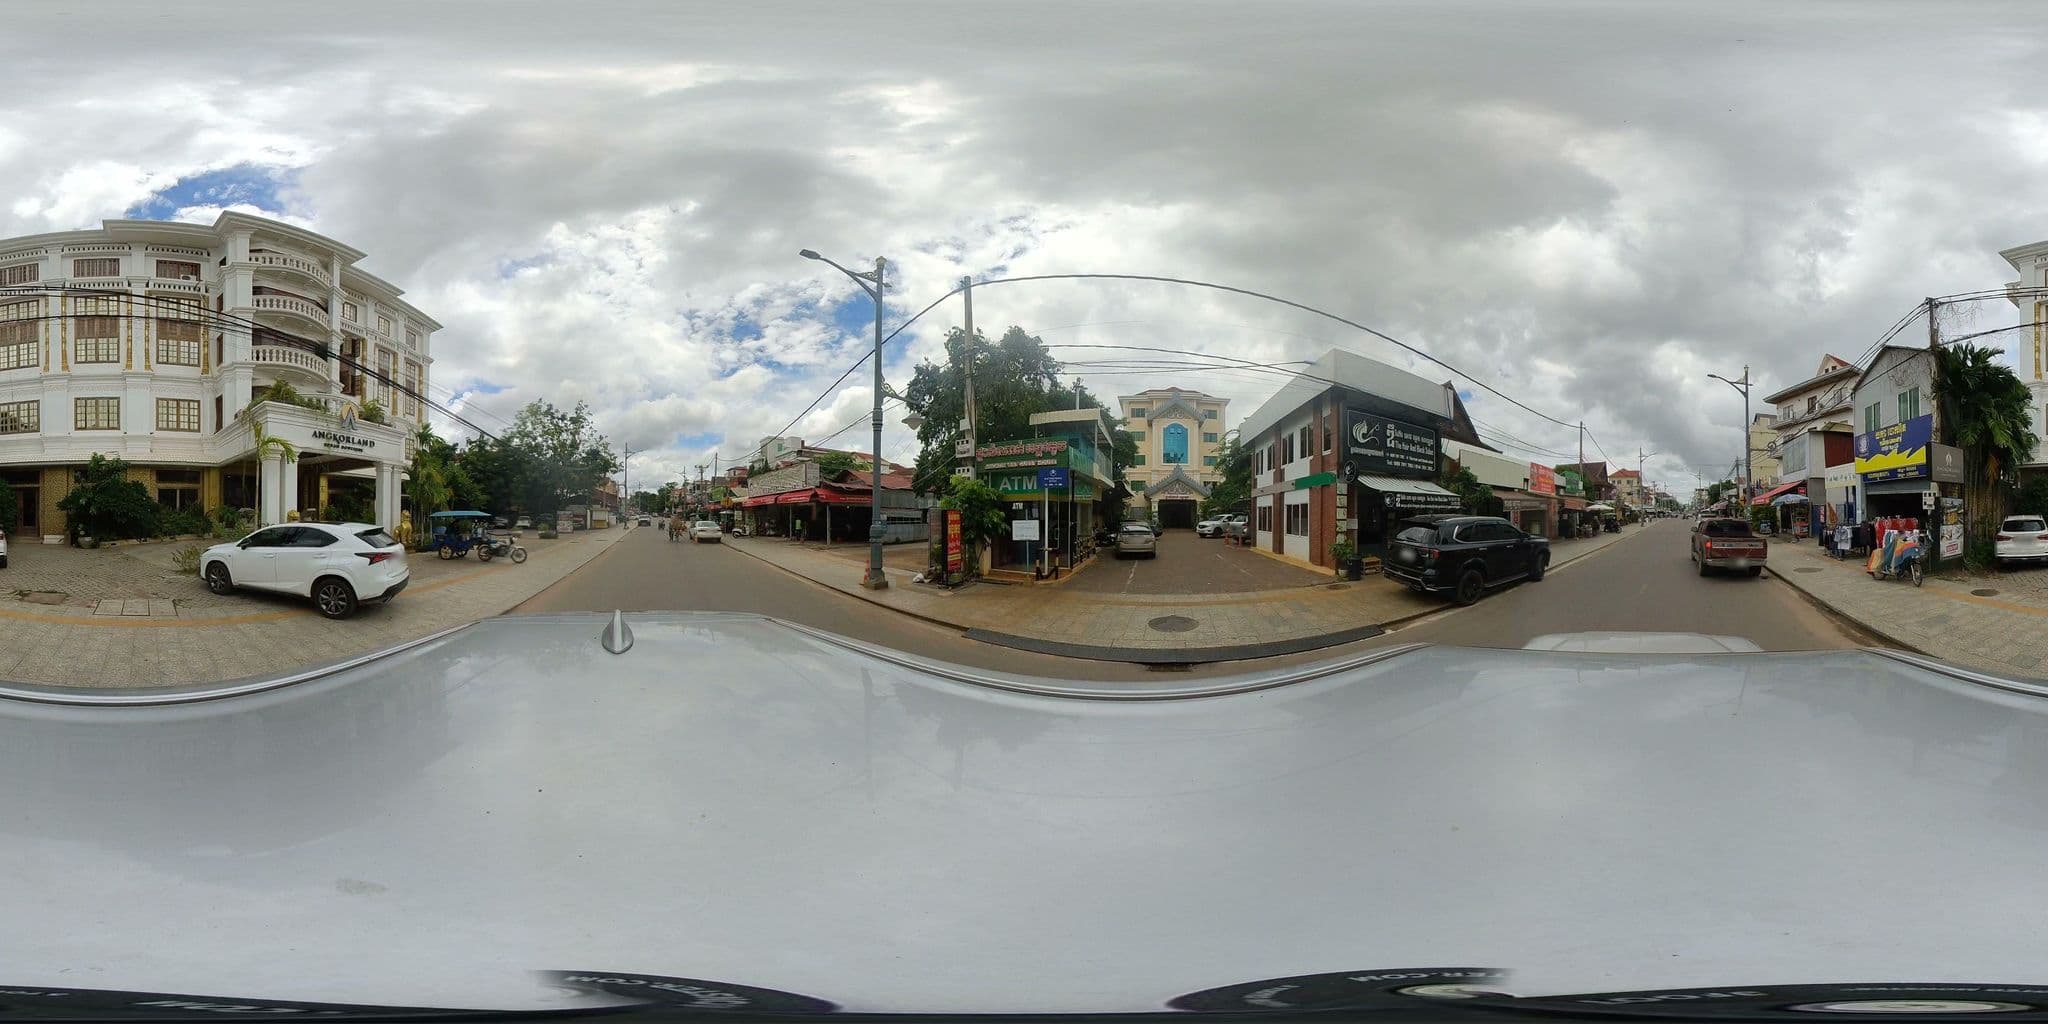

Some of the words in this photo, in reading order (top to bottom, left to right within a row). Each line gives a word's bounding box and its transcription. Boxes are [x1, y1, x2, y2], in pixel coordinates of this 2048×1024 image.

[312, 430, 375, 448] ANGKORLAND
[999, 475, 1037, 491] ATM
[1012, 502, 1023, 510] ATM
